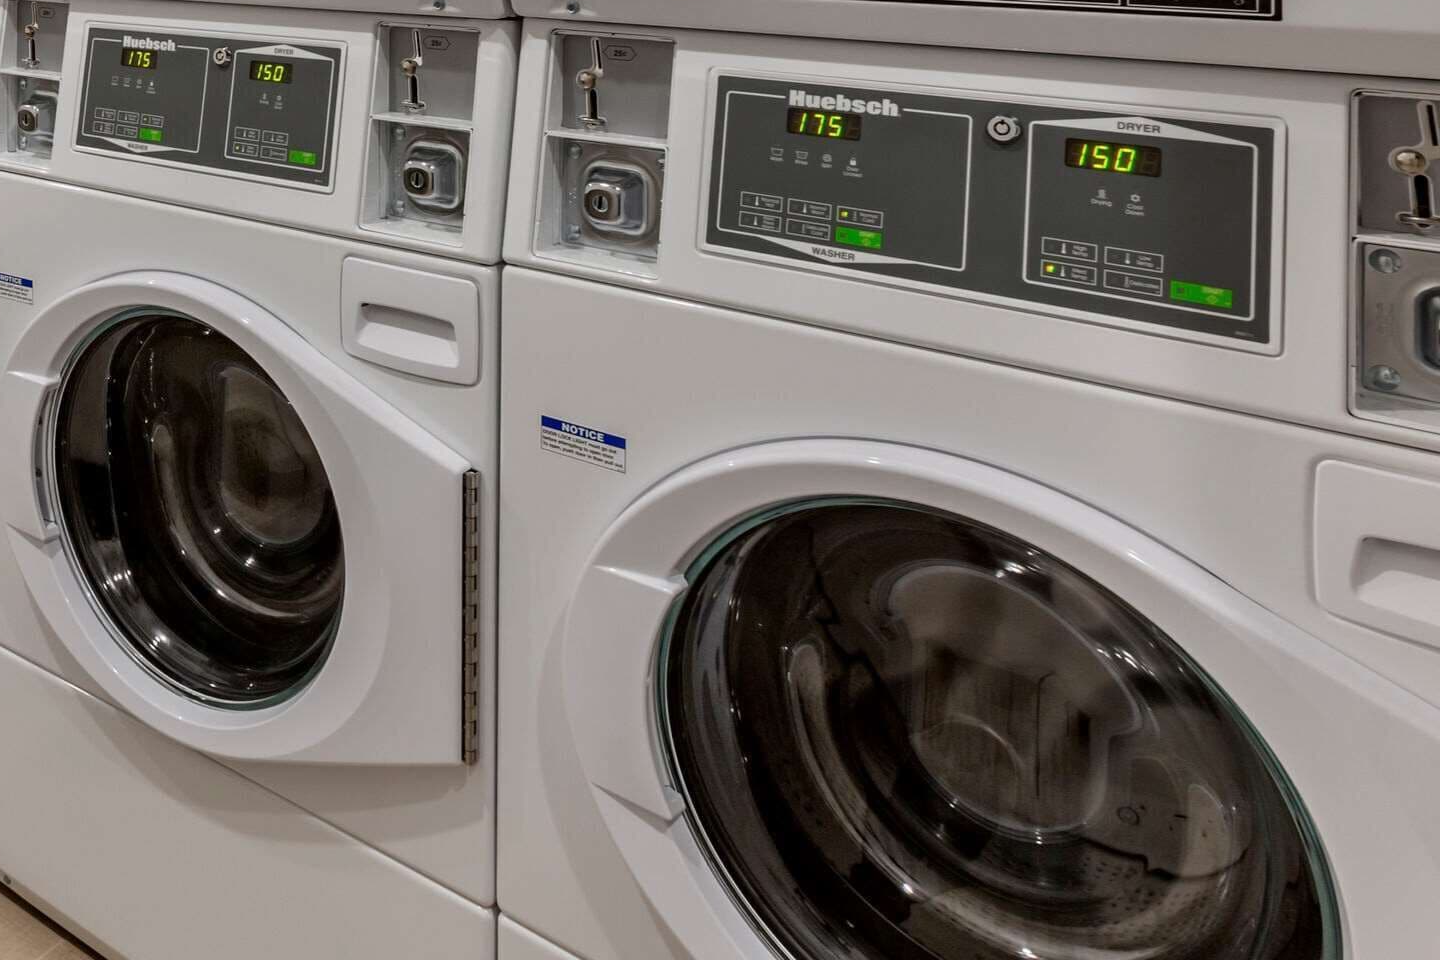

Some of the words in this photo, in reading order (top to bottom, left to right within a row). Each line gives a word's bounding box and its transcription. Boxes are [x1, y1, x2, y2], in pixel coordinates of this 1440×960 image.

[123, 35, 176, 51] Huebsch
[128, 51, 151, 67] 175
[257, 63, 284, 82] 150
[789, 89, 900, 117] Huebsch
[800, 112, 842, 136] 175
[1117, 121, 1161, 133] DRYER
[1079, 143, 1136, 172] 150
[811, 247, 856, 261] WASHER
[561, 423, 604, 442] NOTICE
